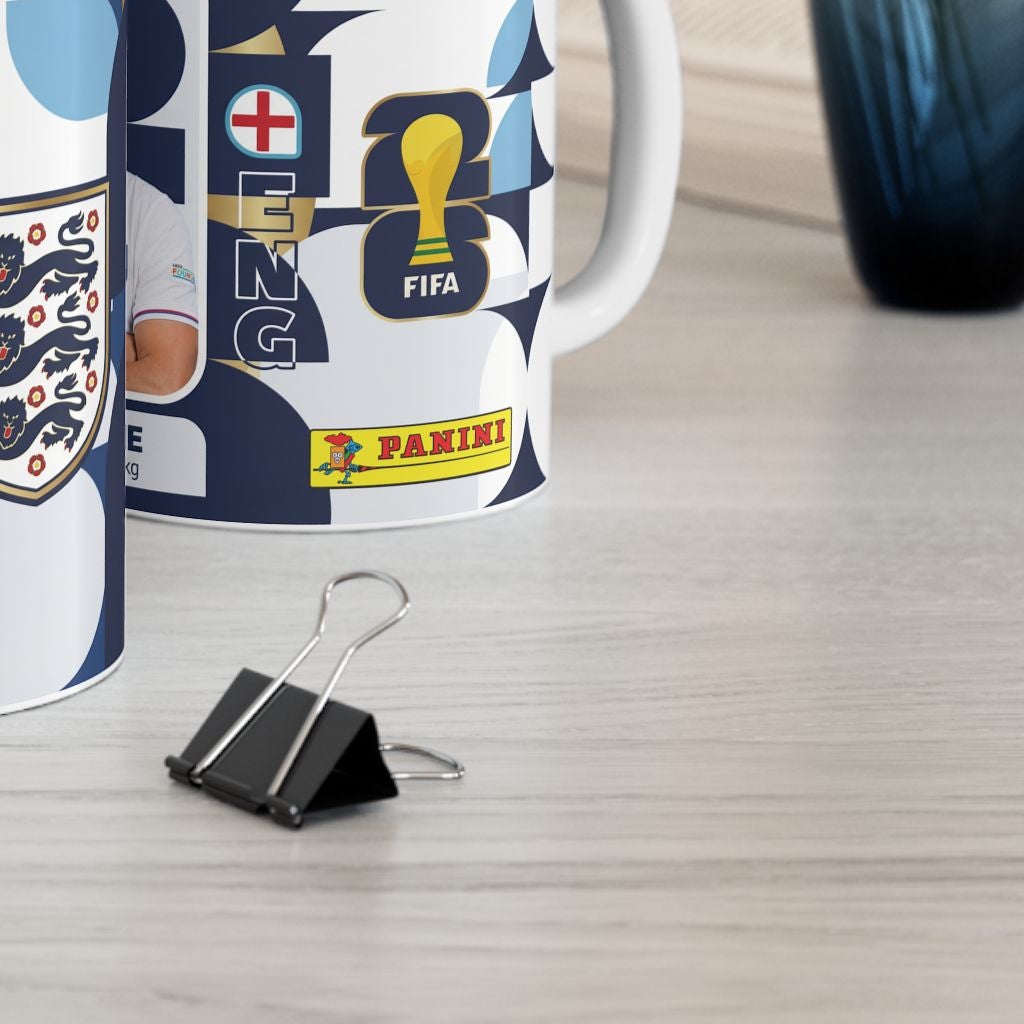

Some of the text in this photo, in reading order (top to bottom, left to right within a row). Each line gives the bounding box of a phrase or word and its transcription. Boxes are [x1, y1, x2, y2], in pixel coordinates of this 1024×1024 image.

[234, 171, 299, 370] ENG
[404, 271, 460, 299] FIFA
[378, 418, 506, 461] PANINI
